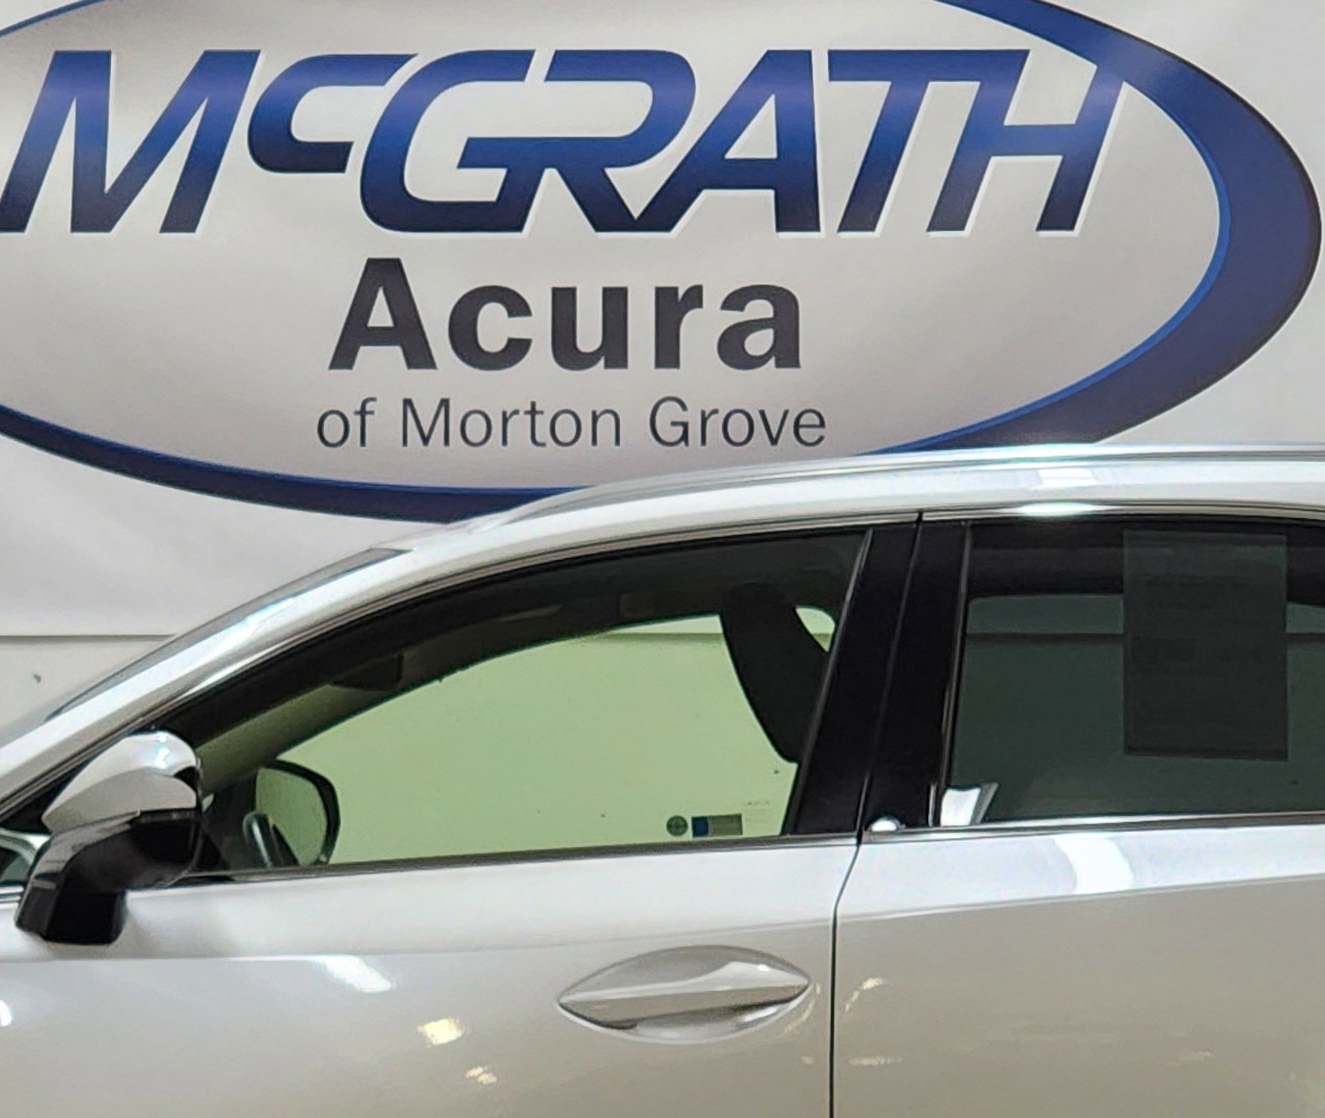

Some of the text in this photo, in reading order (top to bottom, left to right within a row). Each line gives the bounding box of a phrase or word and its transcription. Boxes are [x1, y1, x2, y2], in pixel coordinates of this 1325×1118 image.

[328, 257, 802, 371] Acura
[316, 395, 828, 449] of Morton Grove
